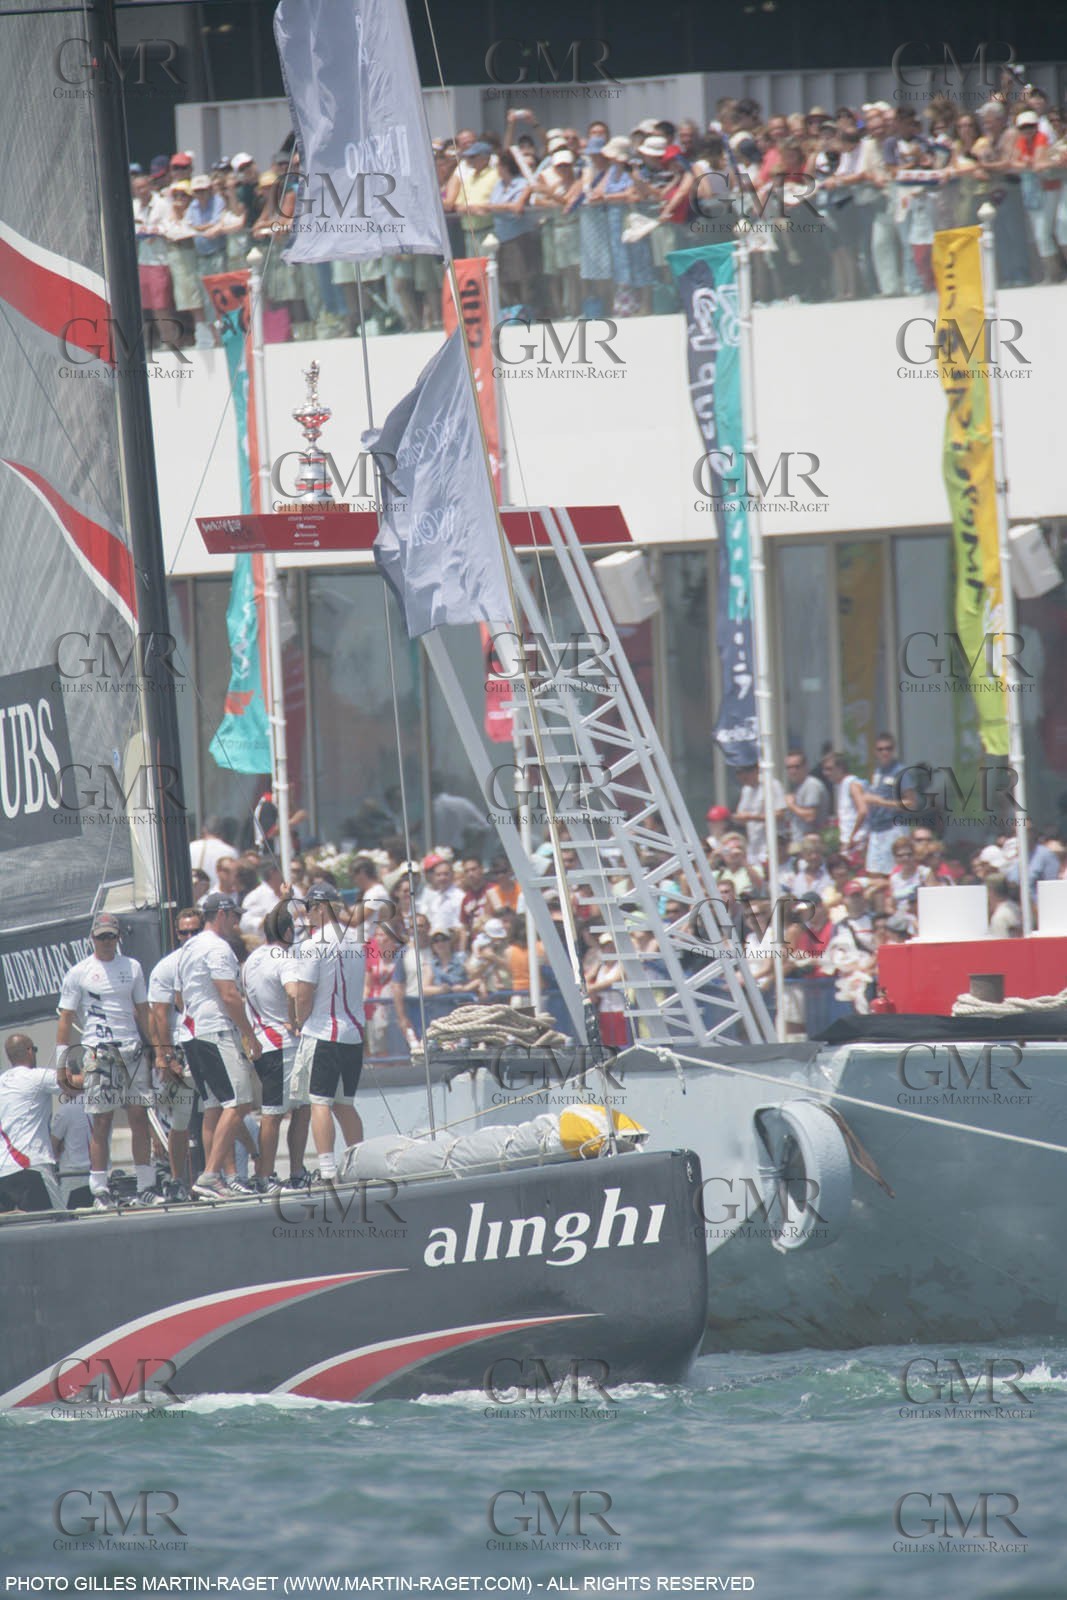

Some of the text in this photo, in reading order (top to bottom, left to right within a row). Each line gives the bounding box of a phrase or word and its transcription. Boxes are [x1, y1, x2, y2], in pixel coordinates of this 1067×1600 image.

[0, 698, 62, 819] UBS
[0, 943, 73, 1003] AUDEMARS
[423, 1187, 666, 1267] alinghi
